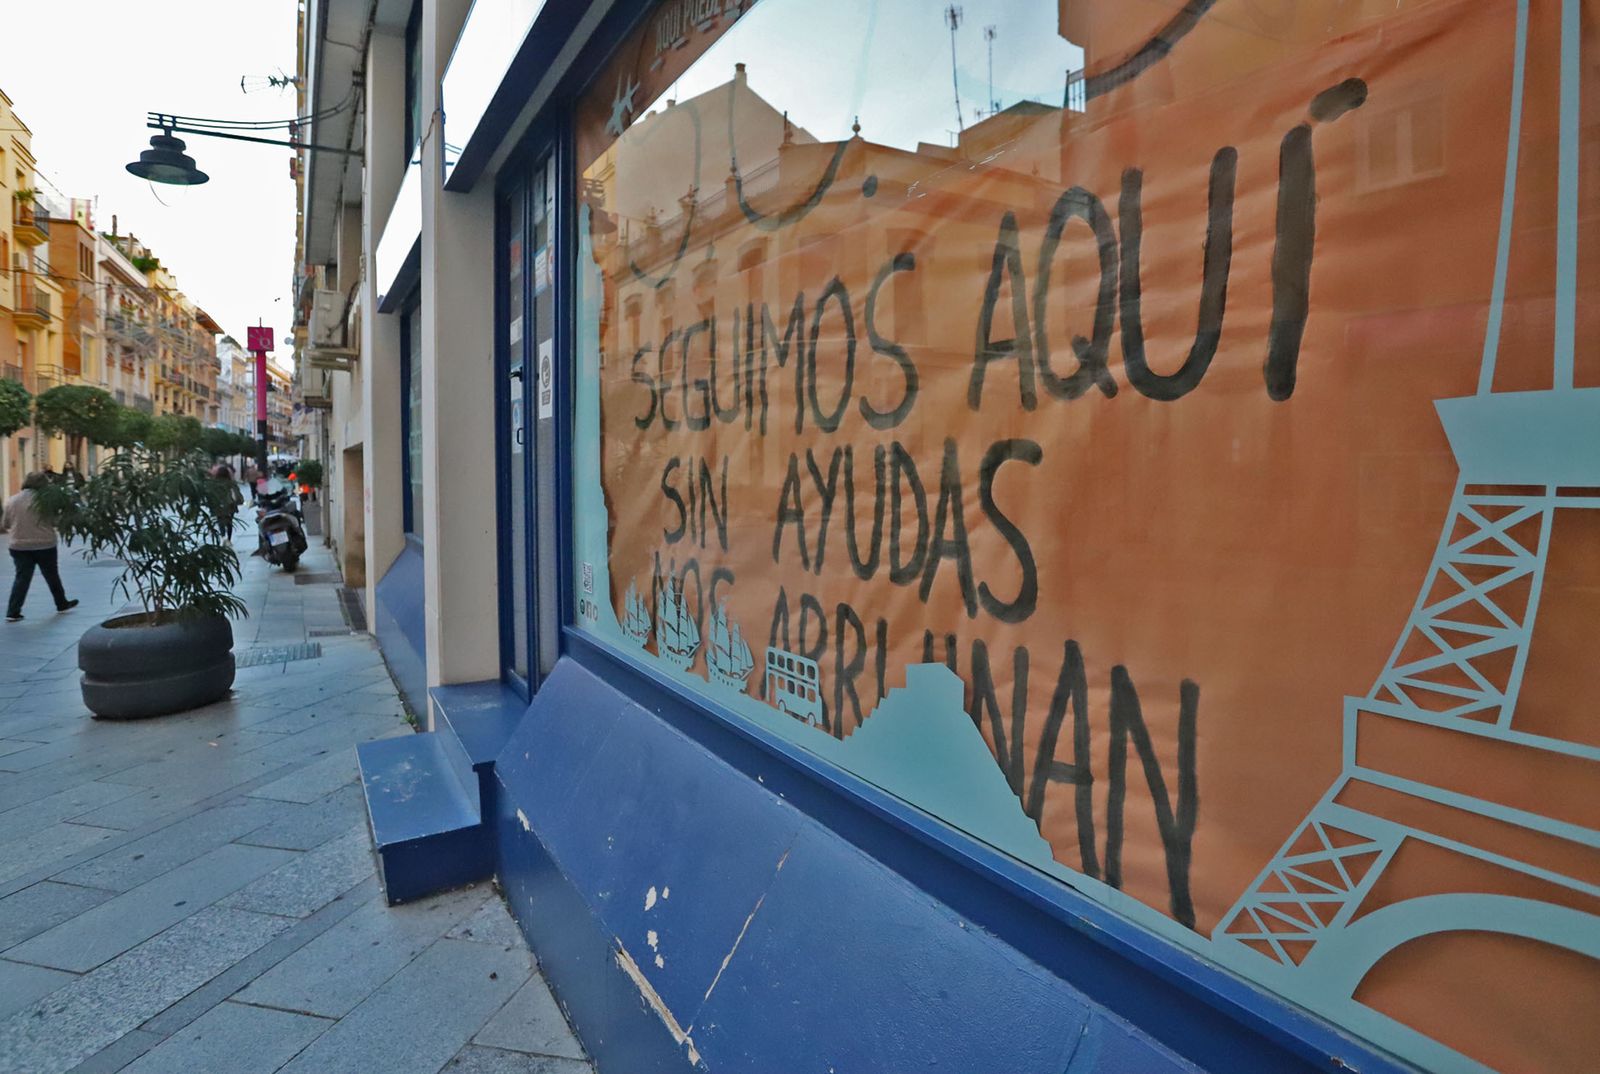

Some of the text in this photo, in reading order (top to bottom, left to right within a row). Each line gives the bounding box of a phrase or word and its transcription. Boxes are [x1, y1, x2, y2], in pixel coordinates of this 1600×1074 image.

[631, 77, 1368, 435] SEGUIMOS AQUÍ
[660, 436, 1044, 623] SIN AYUDAS
[760, 585, 1200, 930] ARRNAN
